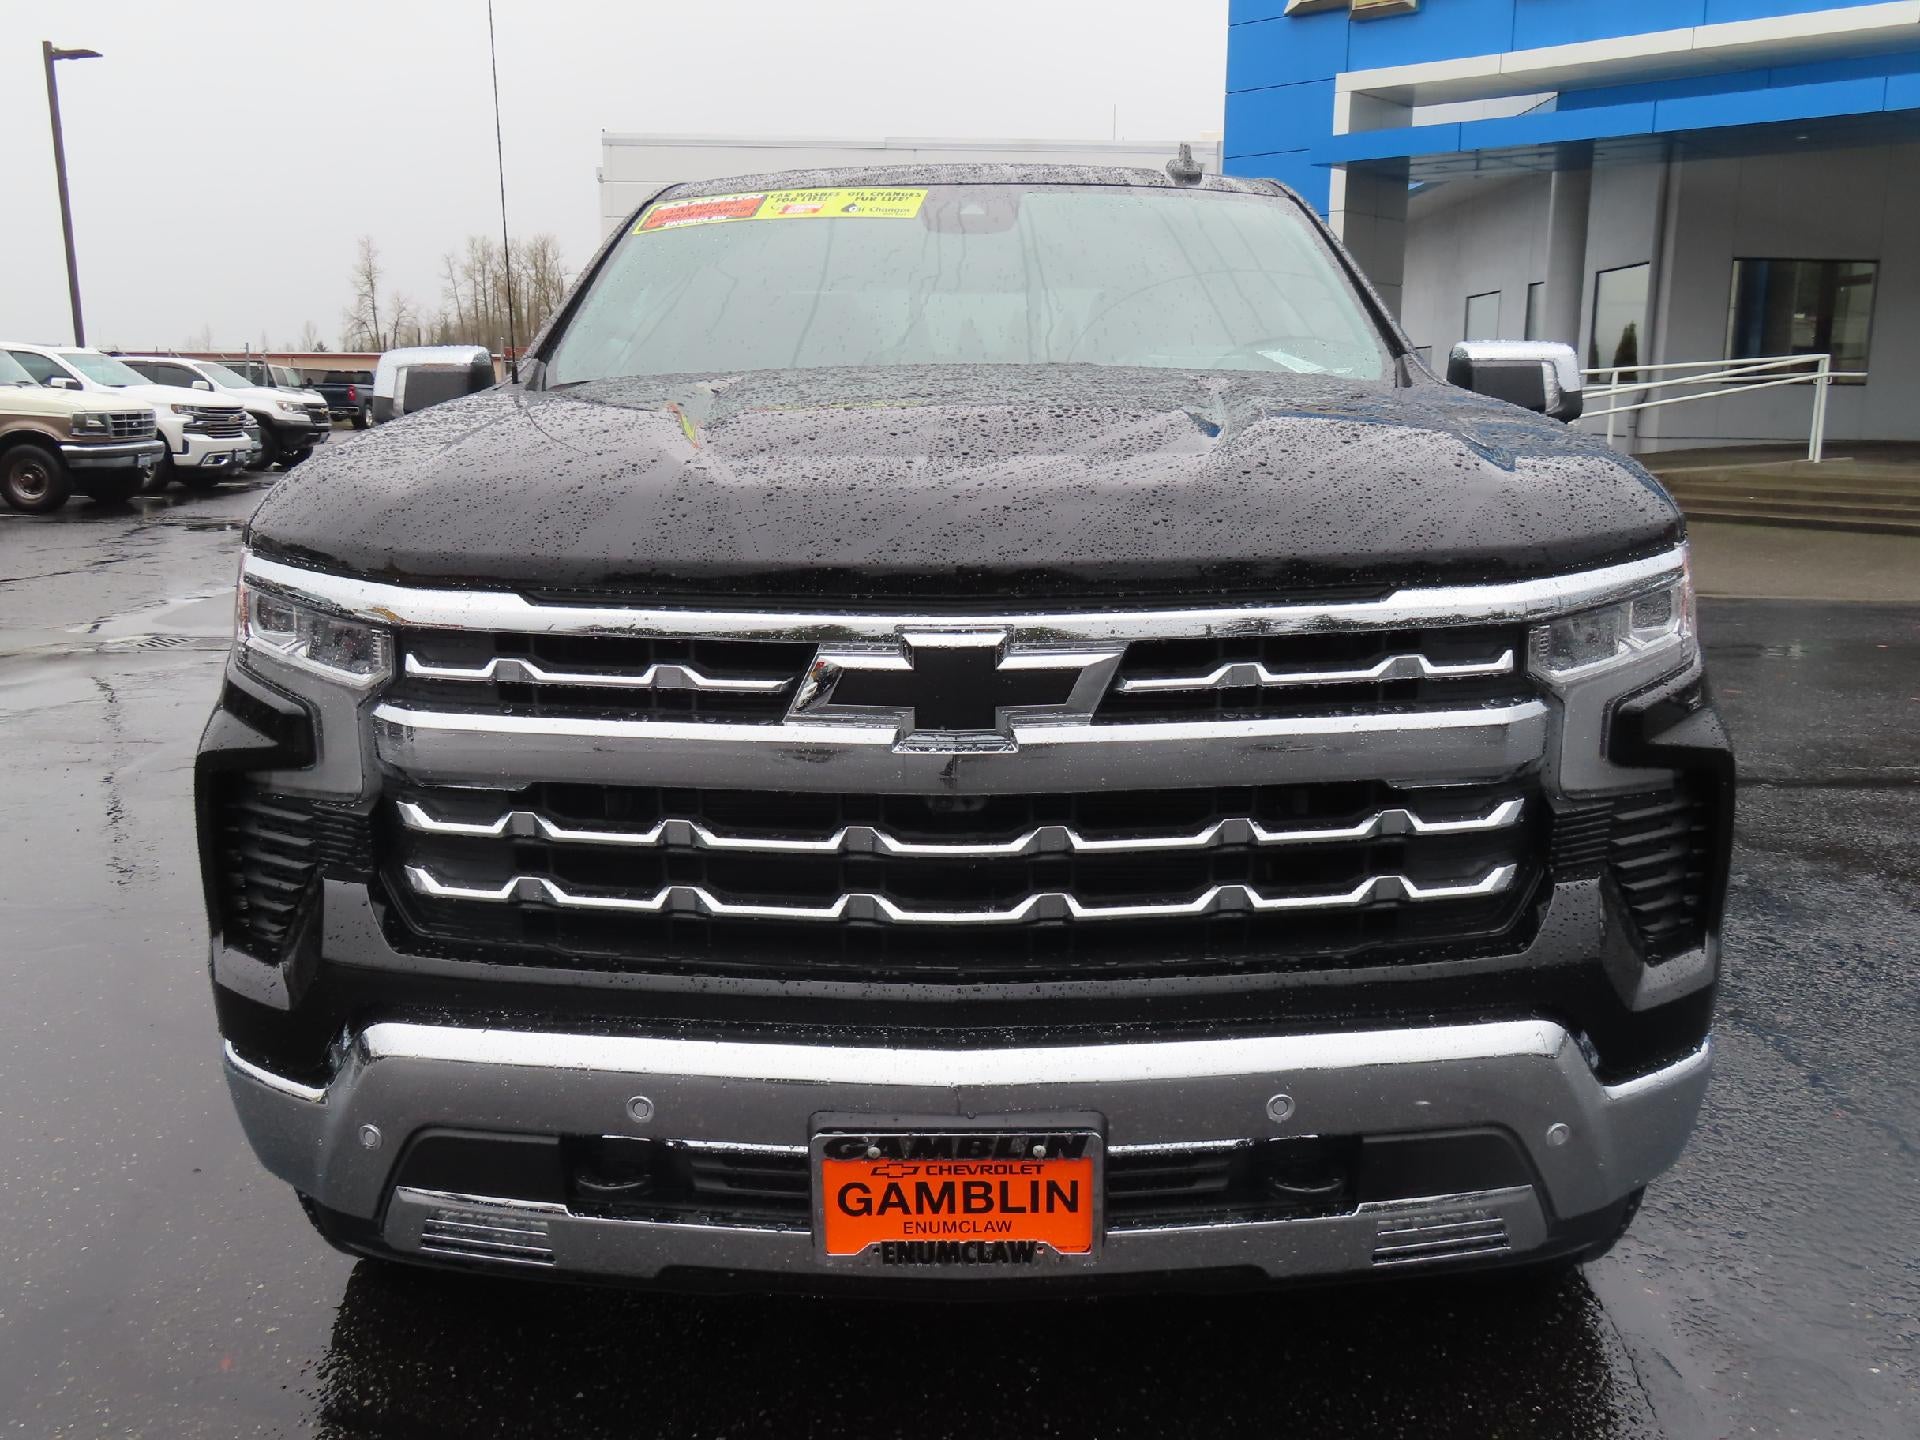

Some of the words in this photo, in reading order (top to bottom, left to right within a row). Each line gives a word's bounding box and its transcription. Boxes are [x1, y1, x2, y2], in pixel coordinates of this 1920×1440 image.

[823, 1136, 1090, 1160] GAMBLIN
[925, 1164, 1045, 1176] CHEVROLET
[837, 1180, 1079, 1217] GAMBLIN
[903, 1220, 1012, 1235] ENUMCLAW
[881, 1240, 1038, 1265] ENUMCLAW
